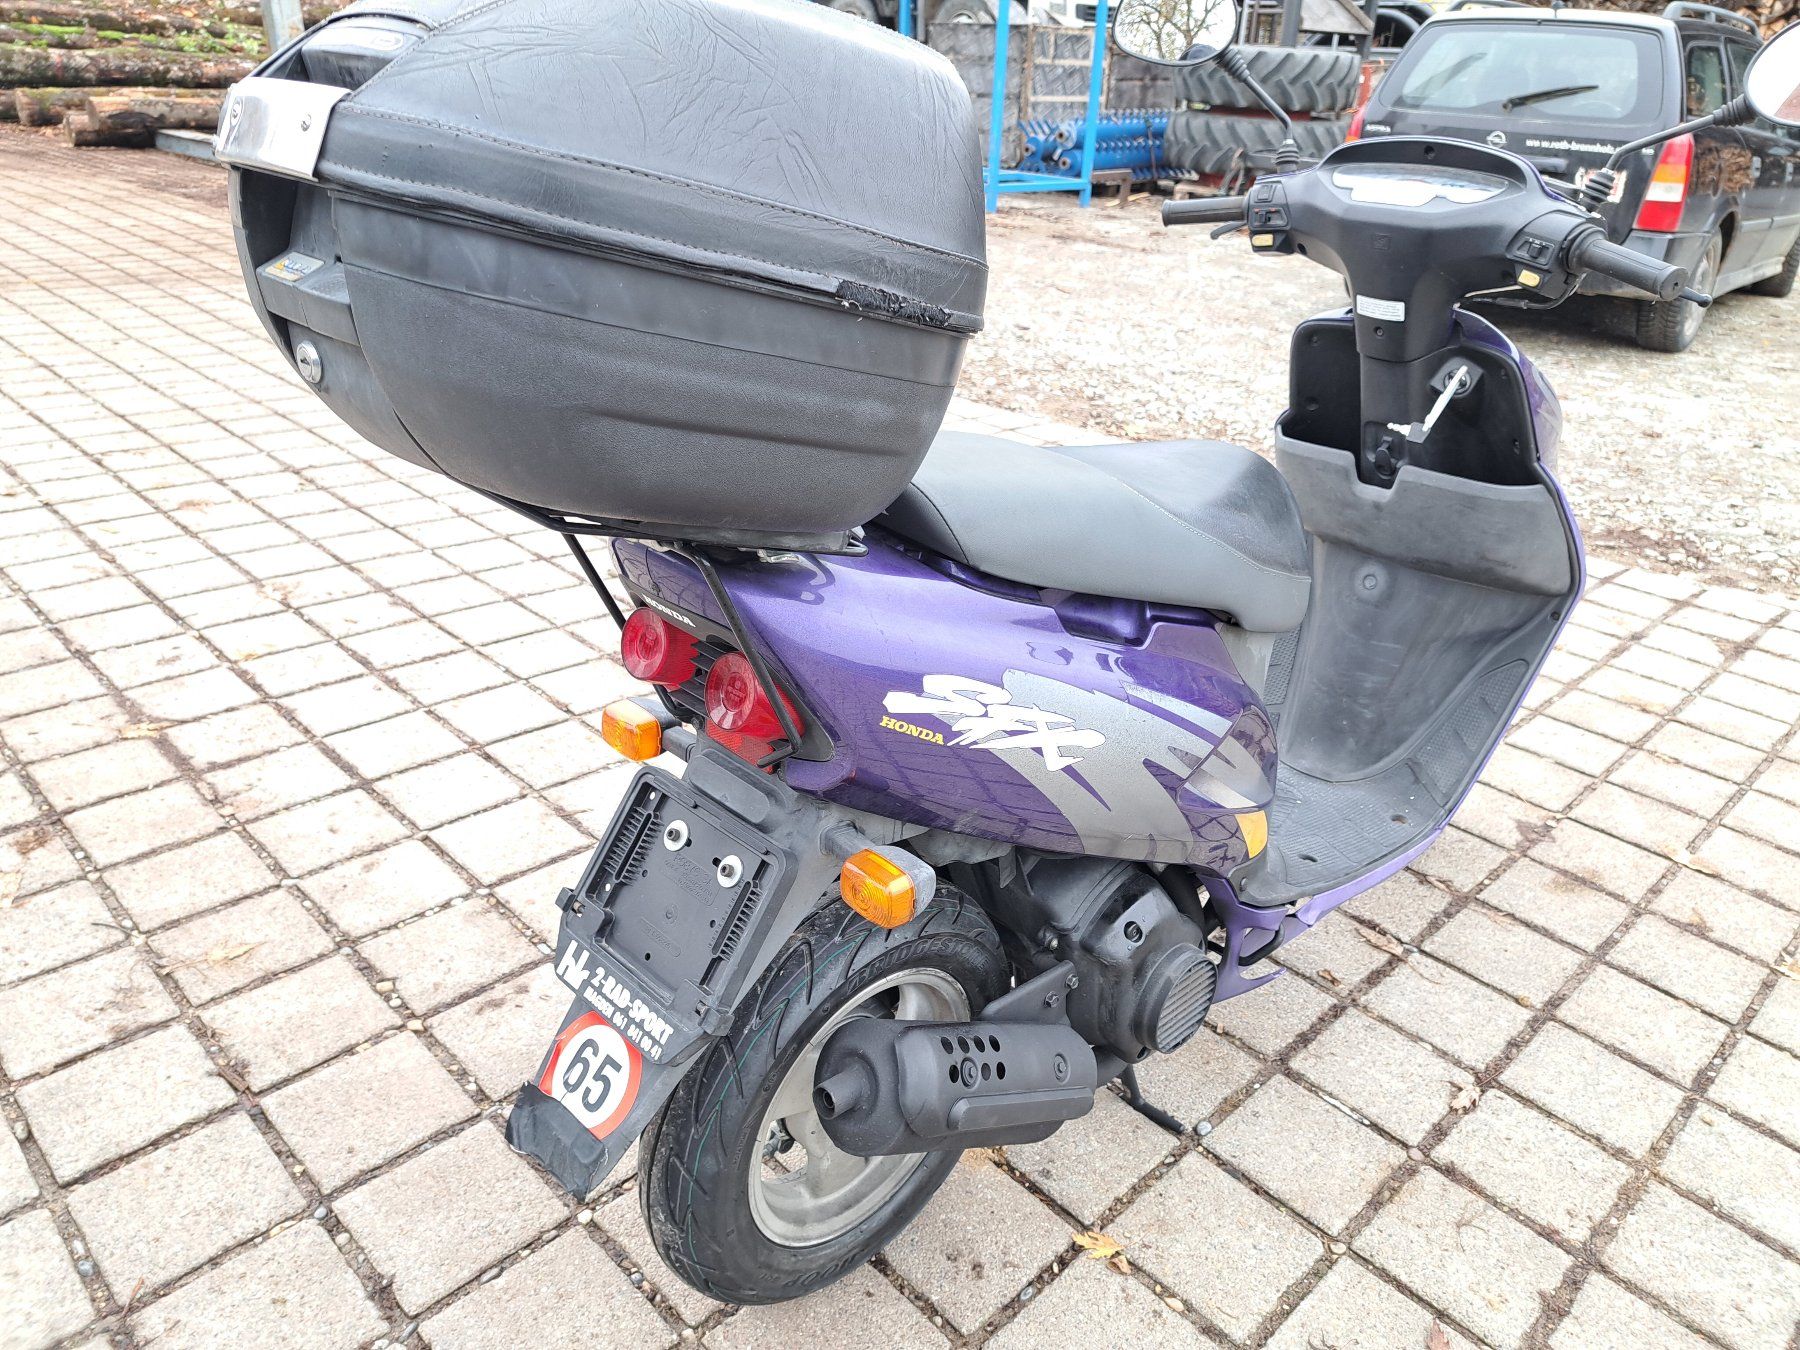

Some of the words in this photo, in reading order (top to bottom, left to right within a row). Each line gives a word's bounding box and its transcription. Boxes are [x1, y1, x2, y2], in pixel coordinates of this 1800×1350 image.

[641, 593, 696, 628] HONDA
[879, 715, 944, 746] HONDA
[591, 967, 674, 1045] 2-RAD-SPORT
[563, 1038, 623, 1112] 65
